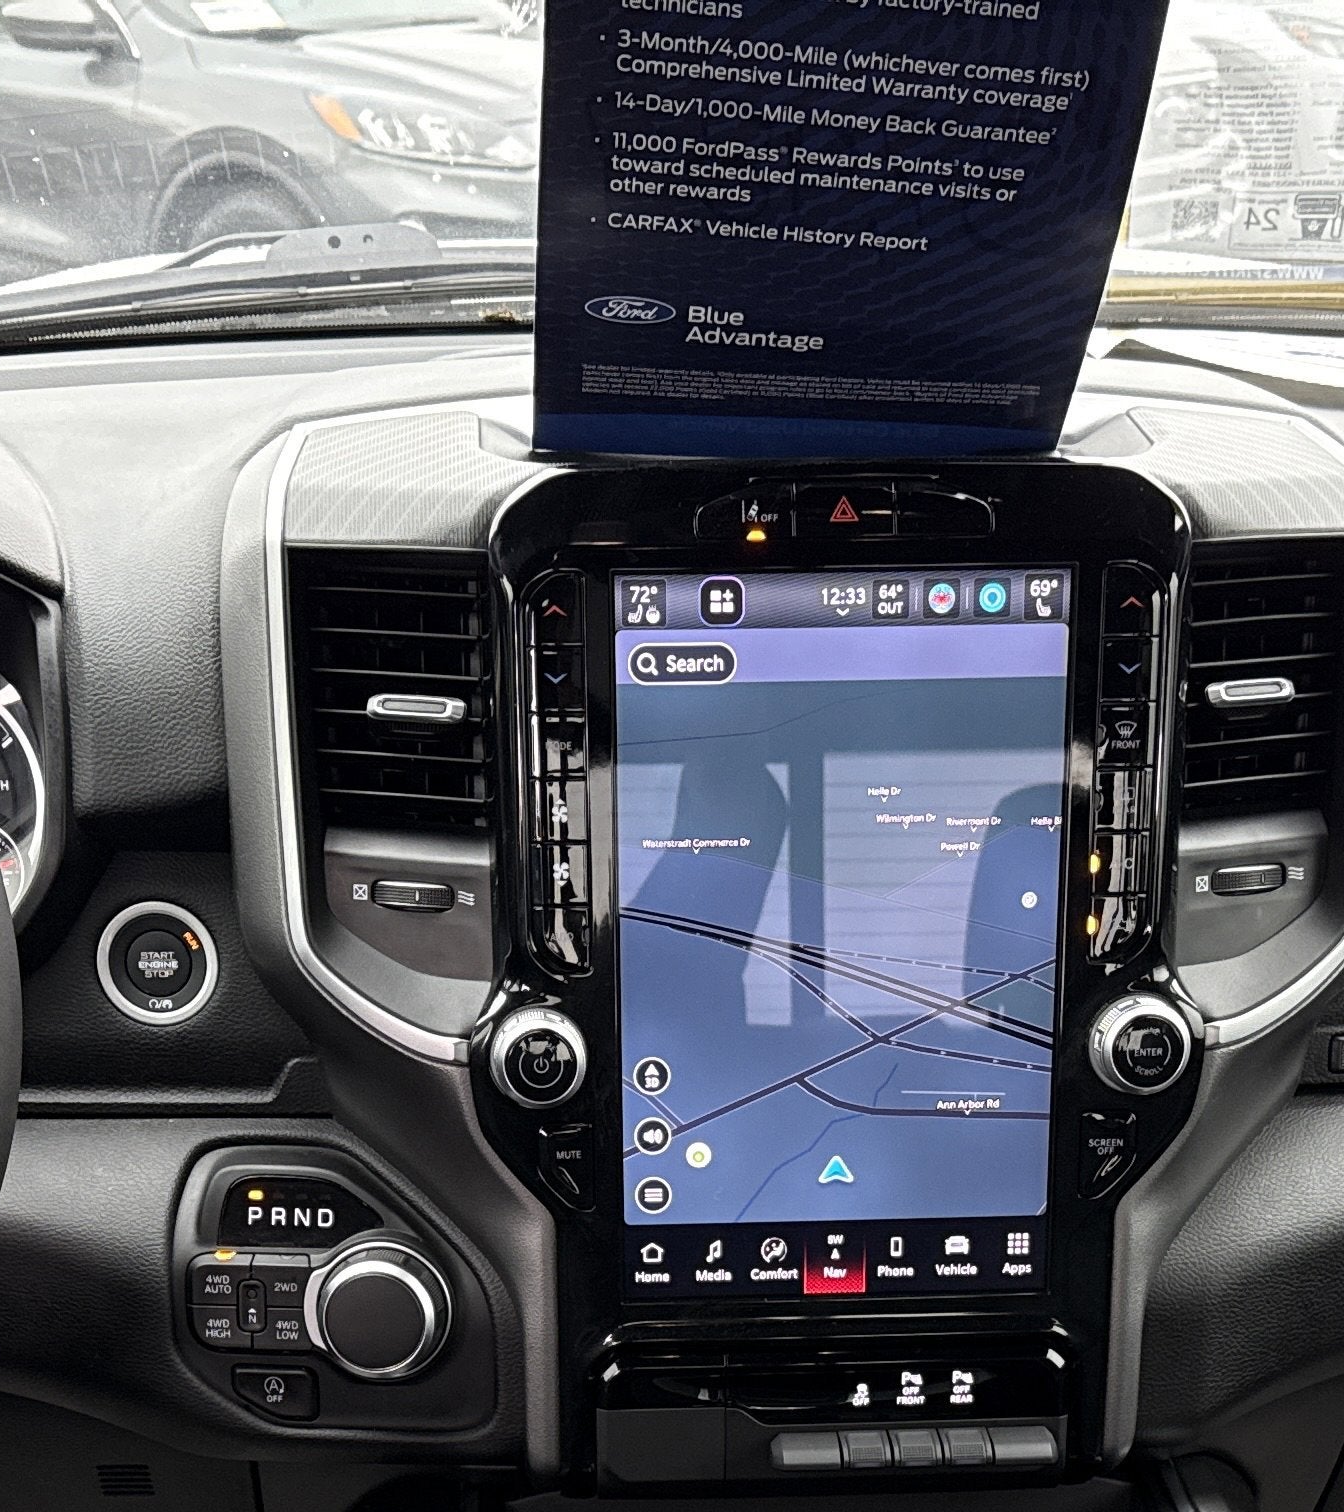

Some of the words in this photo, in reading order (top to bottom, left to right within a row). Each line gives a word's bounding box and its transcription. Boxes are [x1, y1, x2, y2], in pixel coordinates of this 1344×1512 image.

[617, 28, 838, 66] 3-Month/4,000-Mile
[843, 49, 959, 78] (whichever
[964, 63, 1035, 84] comes
[1040, 66, 1090, 91] first)
[616, 54, 782, 86] Comprehensive
[787, 68, 865, 93] Limited
[872, 76, 969, 105] Warranty
[614, 91, 805, 125] 14-Day/1,000-Mile
[810, 108, 881, 134] Money
[885, 115, 936, 136] Back
[612, 131, 677, 153] 11,000
[792, 147, 882, 171] Rewards
[963, 161, 984, 178] to
[988, 167, 1025, 182] use
[611, 155, 685, 176] toward
[689, 162, 796, 185] scheduled
[800, 170, 934, 196] maintenance
[938, 182, 991, 201] visits
[995, 188, 1018, 202] or
[610, 177, 665, 196] other
[669, 183, 752, 203] rewards
[706, 219, 778, 240] Vehicle
[783, 225, 855, 248] History
[859, 231, 929, 251] Report
[602, 299, 658, 321] Ford
[687, 304, 744, 326] Blue
[685, 325, 824, 351] Advantage
[760, 513, 779, 523] OFF
[821, 587, 866, 605] 12:33
[877, 601, 904, 615] OUT
[666, 653, 725, 673] Search
[1111, 739, 1142, 750] FRONT
[891, 786, 902, 796] Dr
[926, 813, 937, 823] Dr
[991, 817, 1002, 825] Dr
[740, 837, 751, 848] Dr
[970, 842, 981, 851] Dr
[140, 951, 175, 960] START
[138, 960, 179, 969] ENGINE
[144, 970, 174, 978] STOP
[1134, 1048, 1163, 1058] ENTER
[1134, 1065, 1164, 1076] SCROLL
[644, 1077, 660, 1089] 3D
[936, 1100, 956, 1110] Ann
[958, 1099, 985, 1109] Arbor
[986, 1098, 1000, 1108] Rd
[1088, 1138, 1124, 1147] SCREEN
[556, 1151, 582, 1160] MUTE
[1097, 1147, 1116, 1155] OFF
[827, 1234, 844, 1245] SW
[823, 1266, 846, 1278] Nav
[877, 1265, 915, 1277] Phone
[935, 1263, 978, 1276] Vehicle
[1002, 1262, 1032, 1275] Apps
[635, 1272, 670, 1283] Home
[695, 1269, 732, 1282] Media
[750, 1268, 799, 1280] Comfort
[206, 1275, 230, 1285] 4WD
[204, 1285, 232, 1294] AUTO
[274, 1282, 298, 1292] 2WD
[207, 1319, 230, 1328] 4WD
[248, 1314, 257, 1324] N
[275, 1321, 299, 1330] 4WD
[206, 1329, 231, 1338] HIGH
[276, 1331, 299, 1340] LOW
[901, 1386, 920, 1395] OFF
[952, 1385, 971, 1394] OFF
[266, 1395, 283, 1403] OFF
[852, 1397, 870, 1406] OFF
[896, 1395, 925, 1405] FRONT
[949, 1394, 973, 1404] REAR
